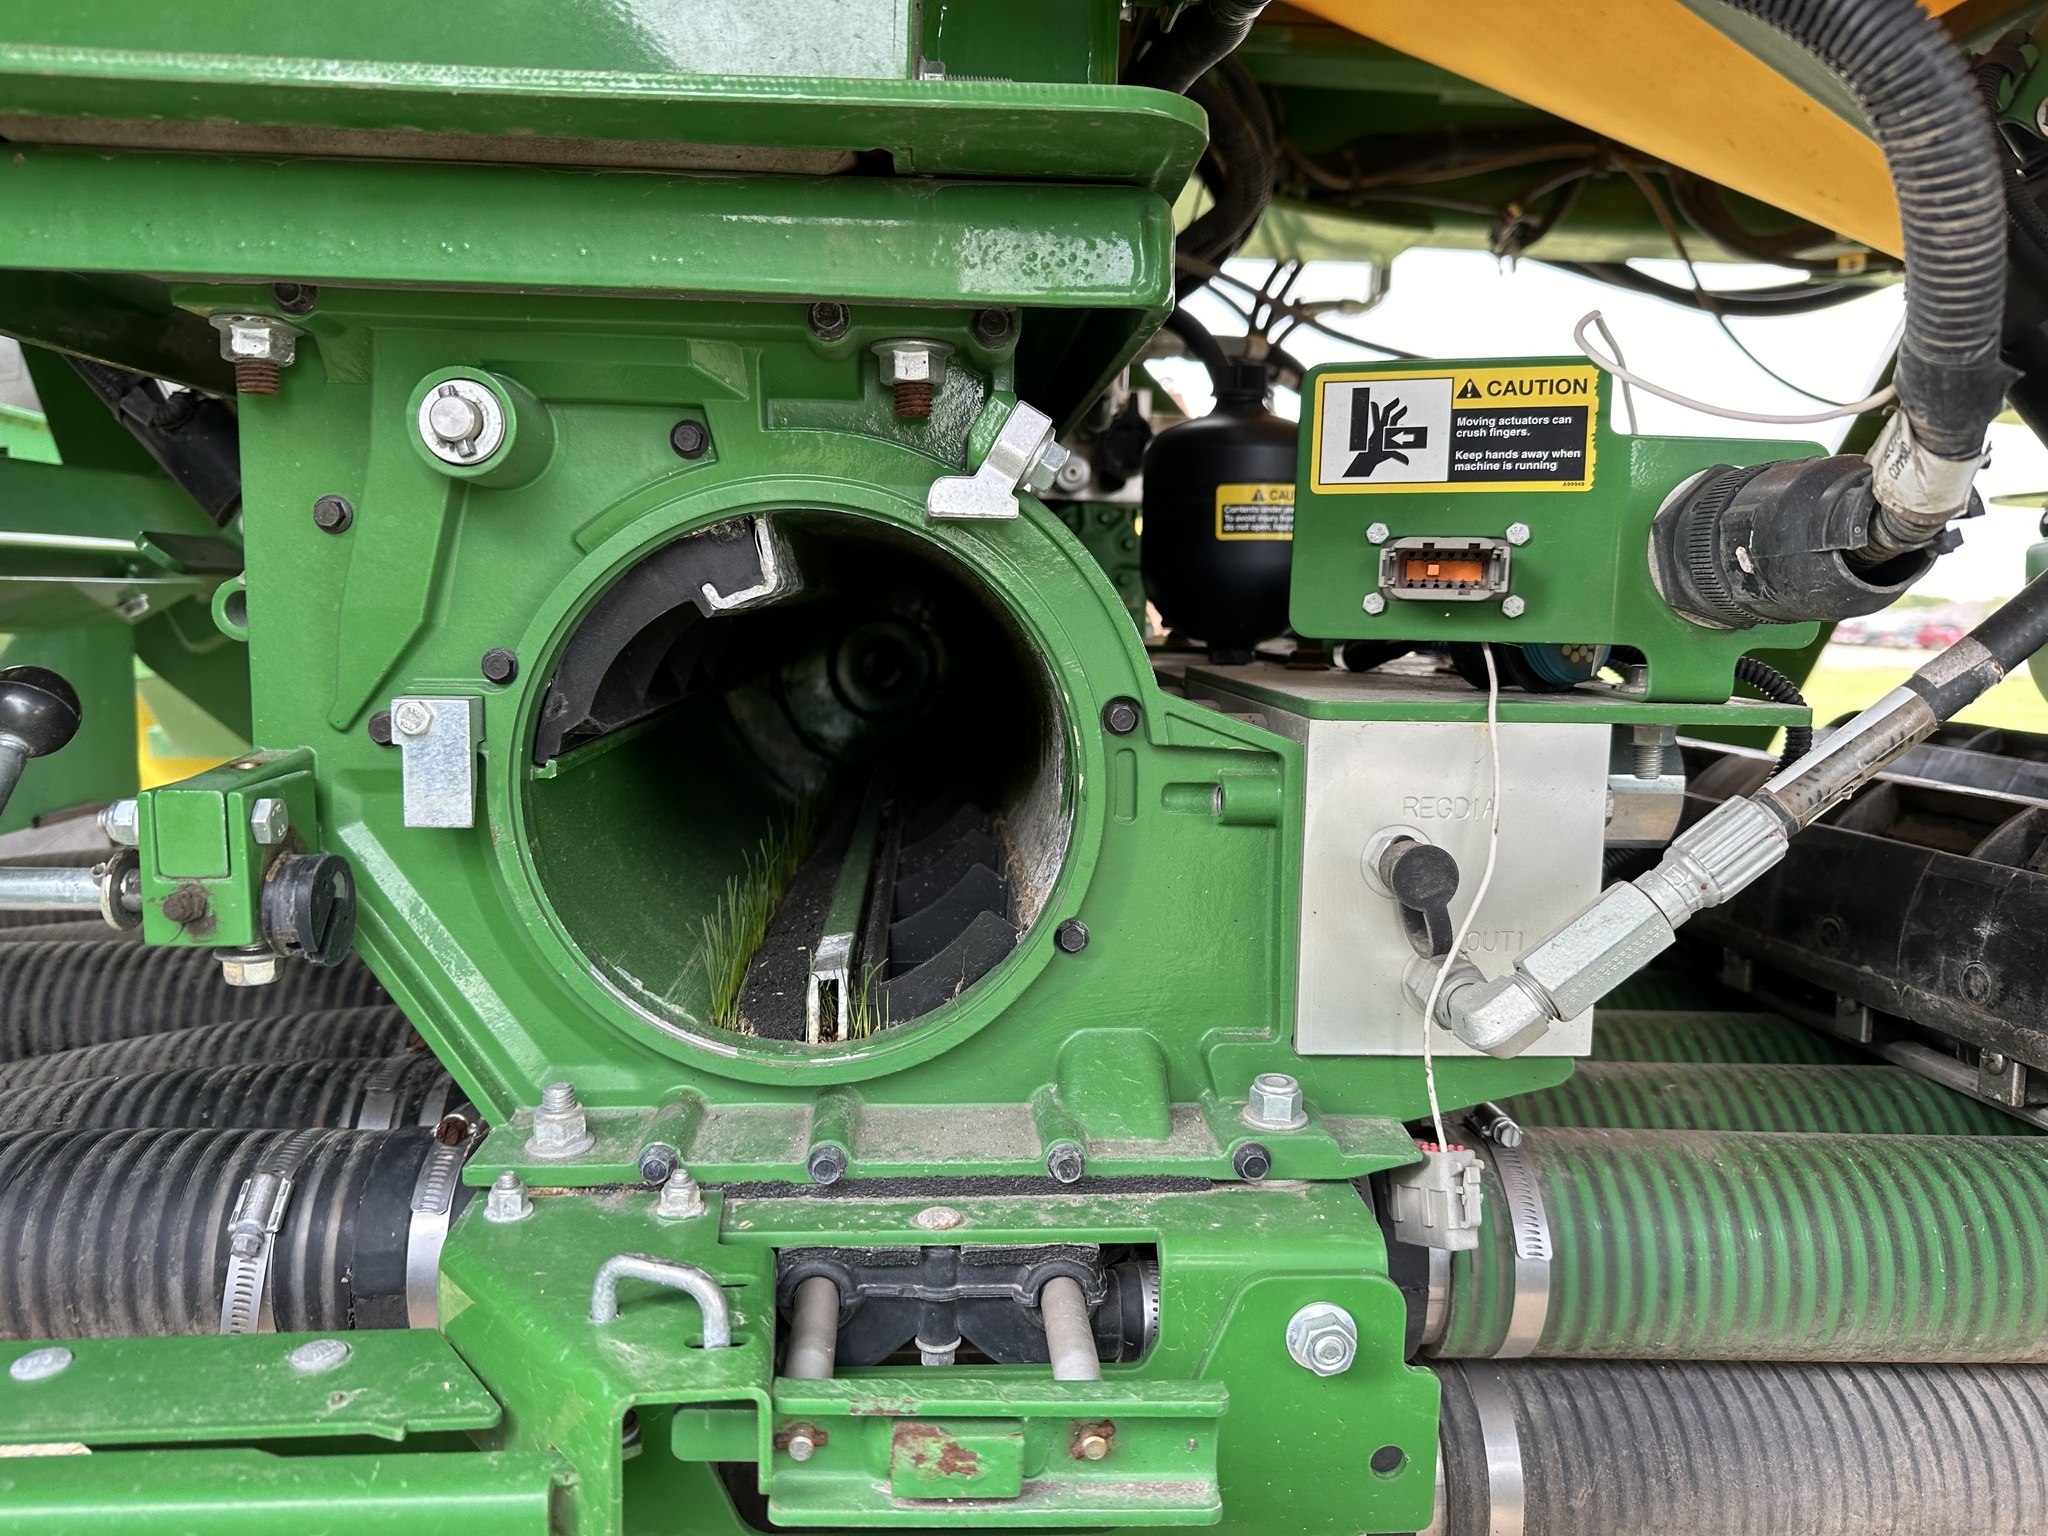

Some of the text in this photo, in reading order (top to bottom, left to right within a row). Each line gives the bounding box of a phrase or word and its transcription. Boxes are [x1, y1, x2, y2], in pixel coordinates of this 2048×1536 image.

[1486, 378, 1588, 396] CAUTION
[1456, 415, 1572, 427] Moving actuators can
[1456, 427, 1531, 438] crush fingers.
[1455, 449, 1581, 461] Keep hands away when
[1454, 460, 1558, 471] machine is running
[1224, 505, 1259, 514] Contents
[1235, 515, 1257, 523] avoid
[1223, 523, 1235, 531] do
